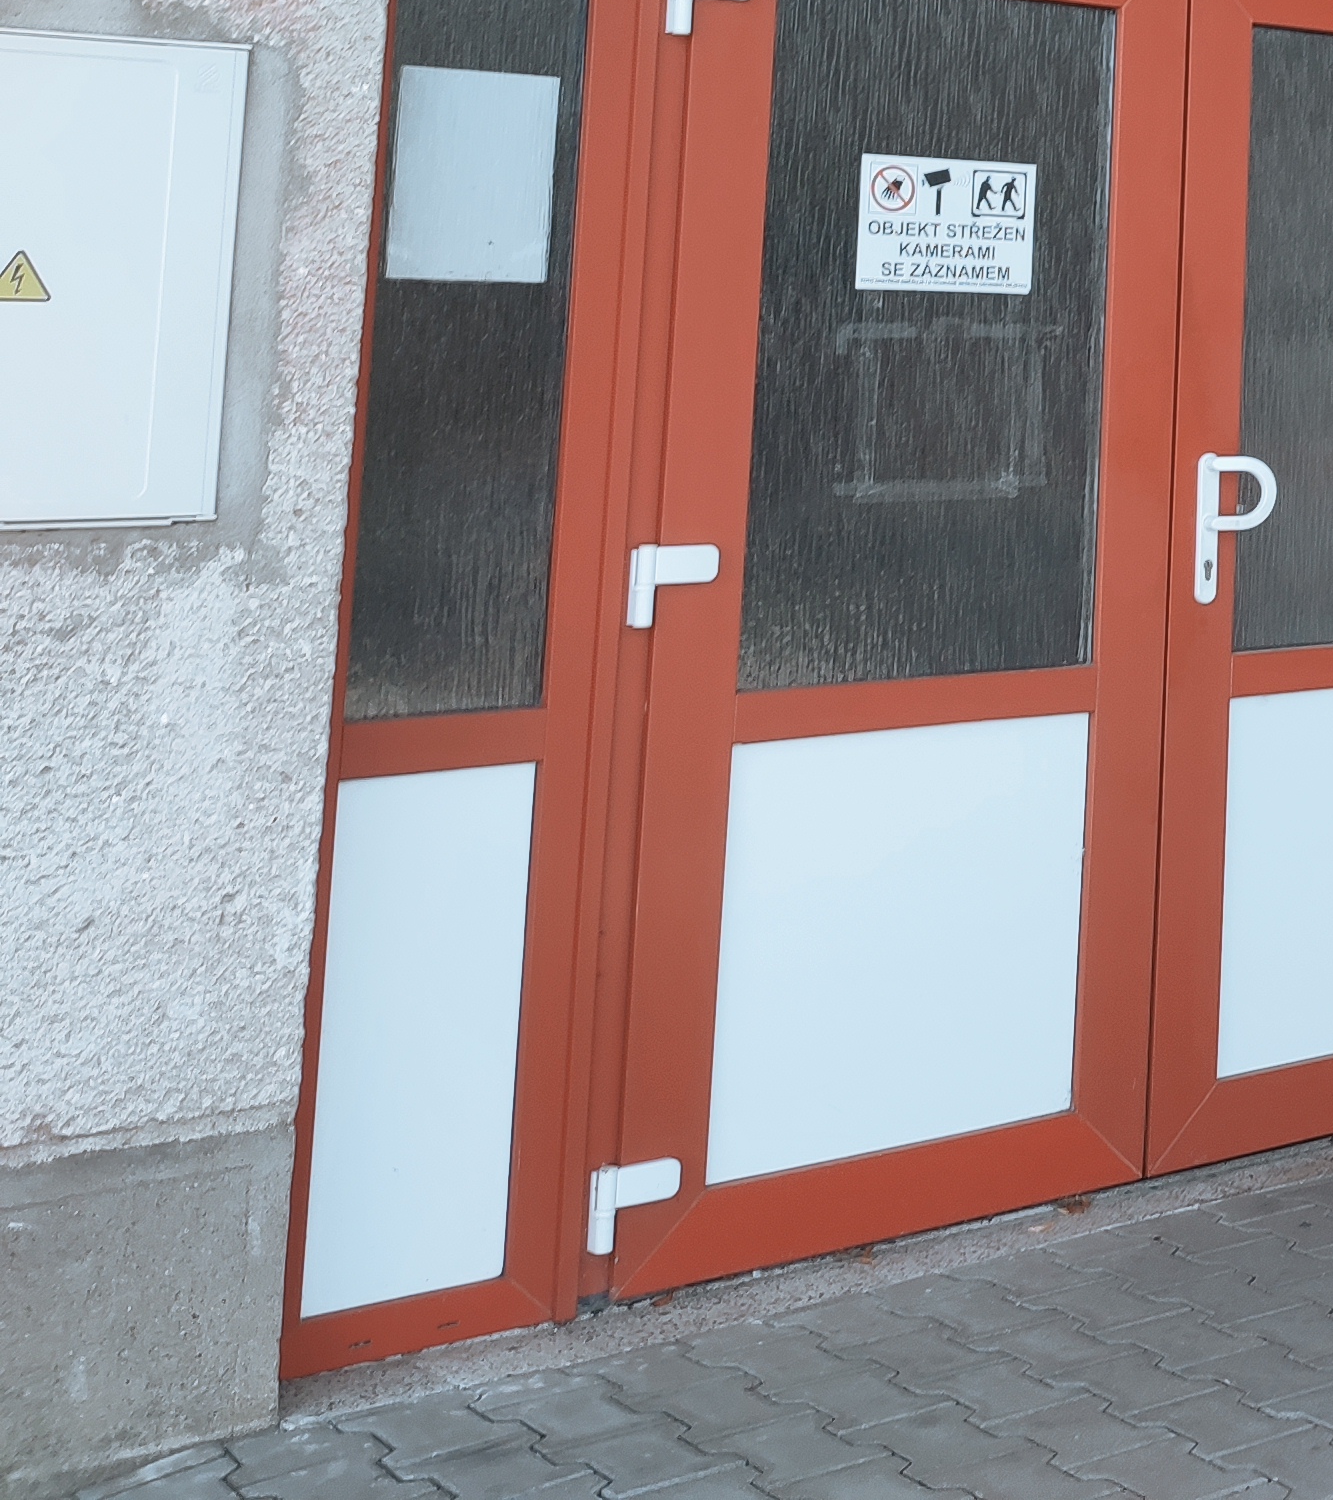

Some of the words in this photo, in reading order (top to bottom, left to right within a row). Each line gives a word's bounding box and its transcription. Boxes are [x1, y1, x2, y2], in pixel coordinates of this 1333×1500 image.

[868, 220, 941, 238] OBJEKT
[946, 220, 1026, 242] STŘEŽEN
[899, 242, 996, 260] KAMERAMI
[881, 261, 905, 277] SE
[909, 259, 1011, 281] ZÁZNAMEM
